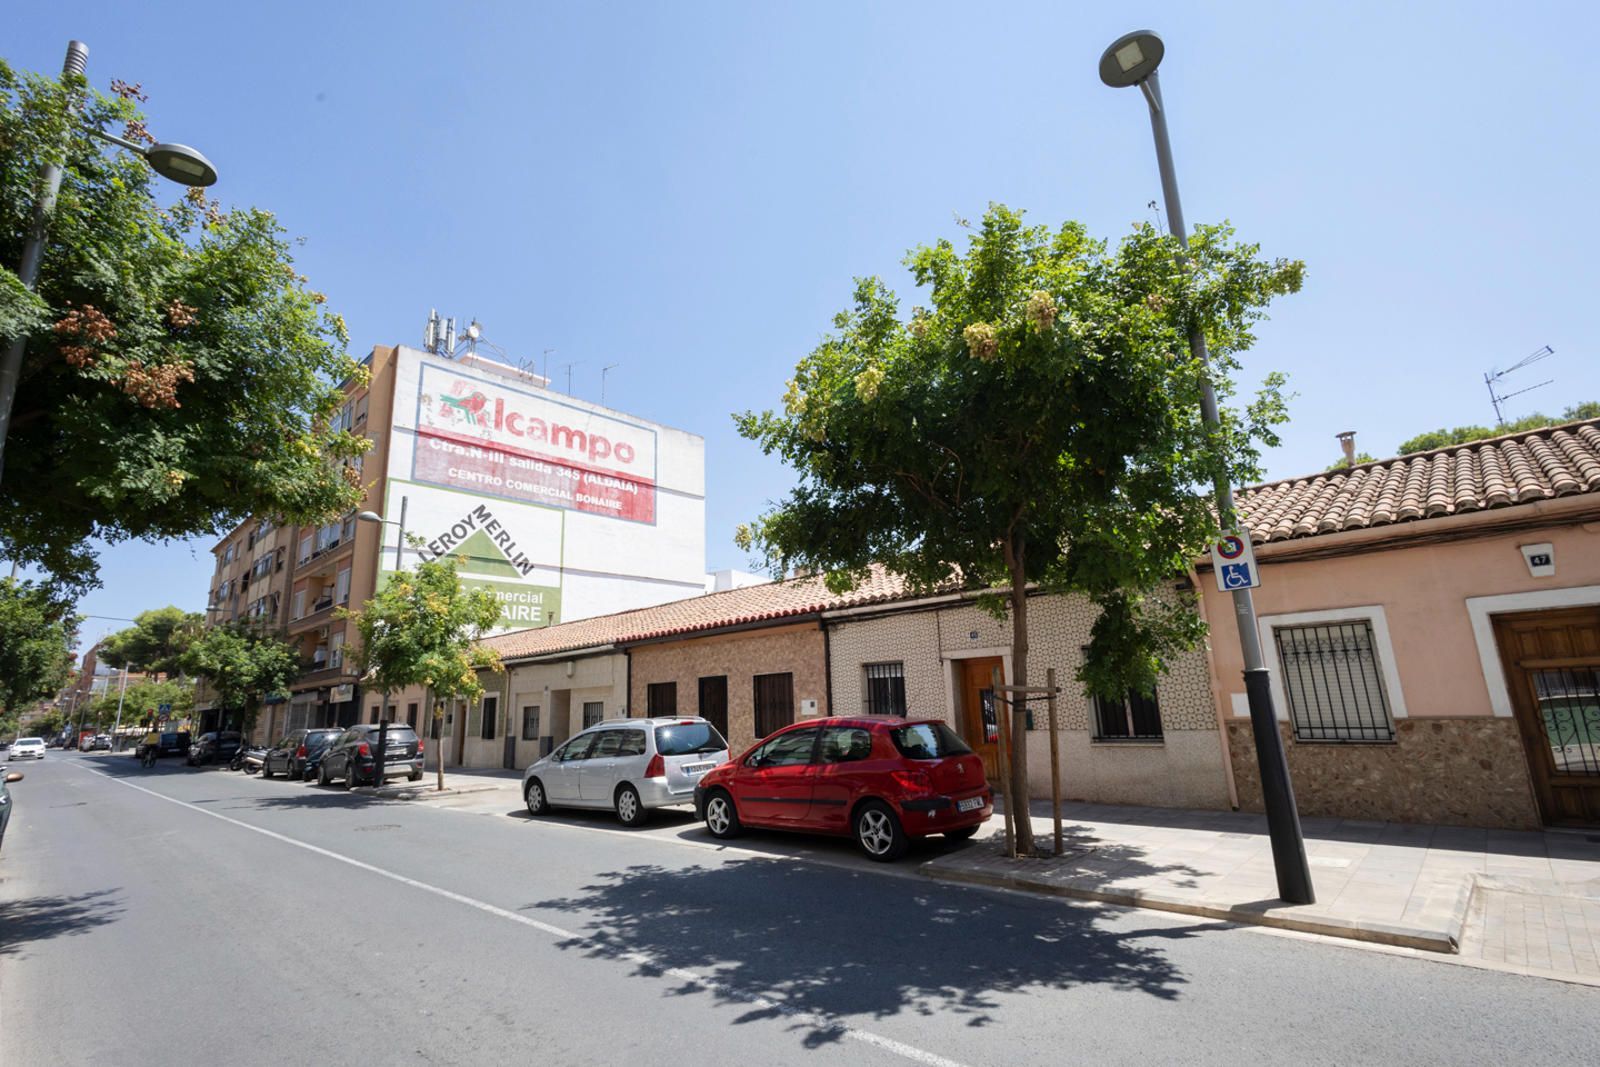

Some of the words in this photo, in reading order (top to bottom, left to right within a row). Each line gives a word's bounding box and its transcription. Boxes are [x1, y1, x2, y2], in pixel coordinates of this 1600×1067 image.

[509, 457, 552, 475] salida
[556, 466, 580, 481] 345
[448, 467, 502, 486] CENTRO
[506, 479, 573, 501] COMERCIAL
[576, 493, 623, 510] BONAIRE
[417, 514, 476, 563] LEROY
[472, 504, 535, 577] MERLIN
[1533, 555, 1547, 565] 47
[501, 605, 542, 622] AIRE
